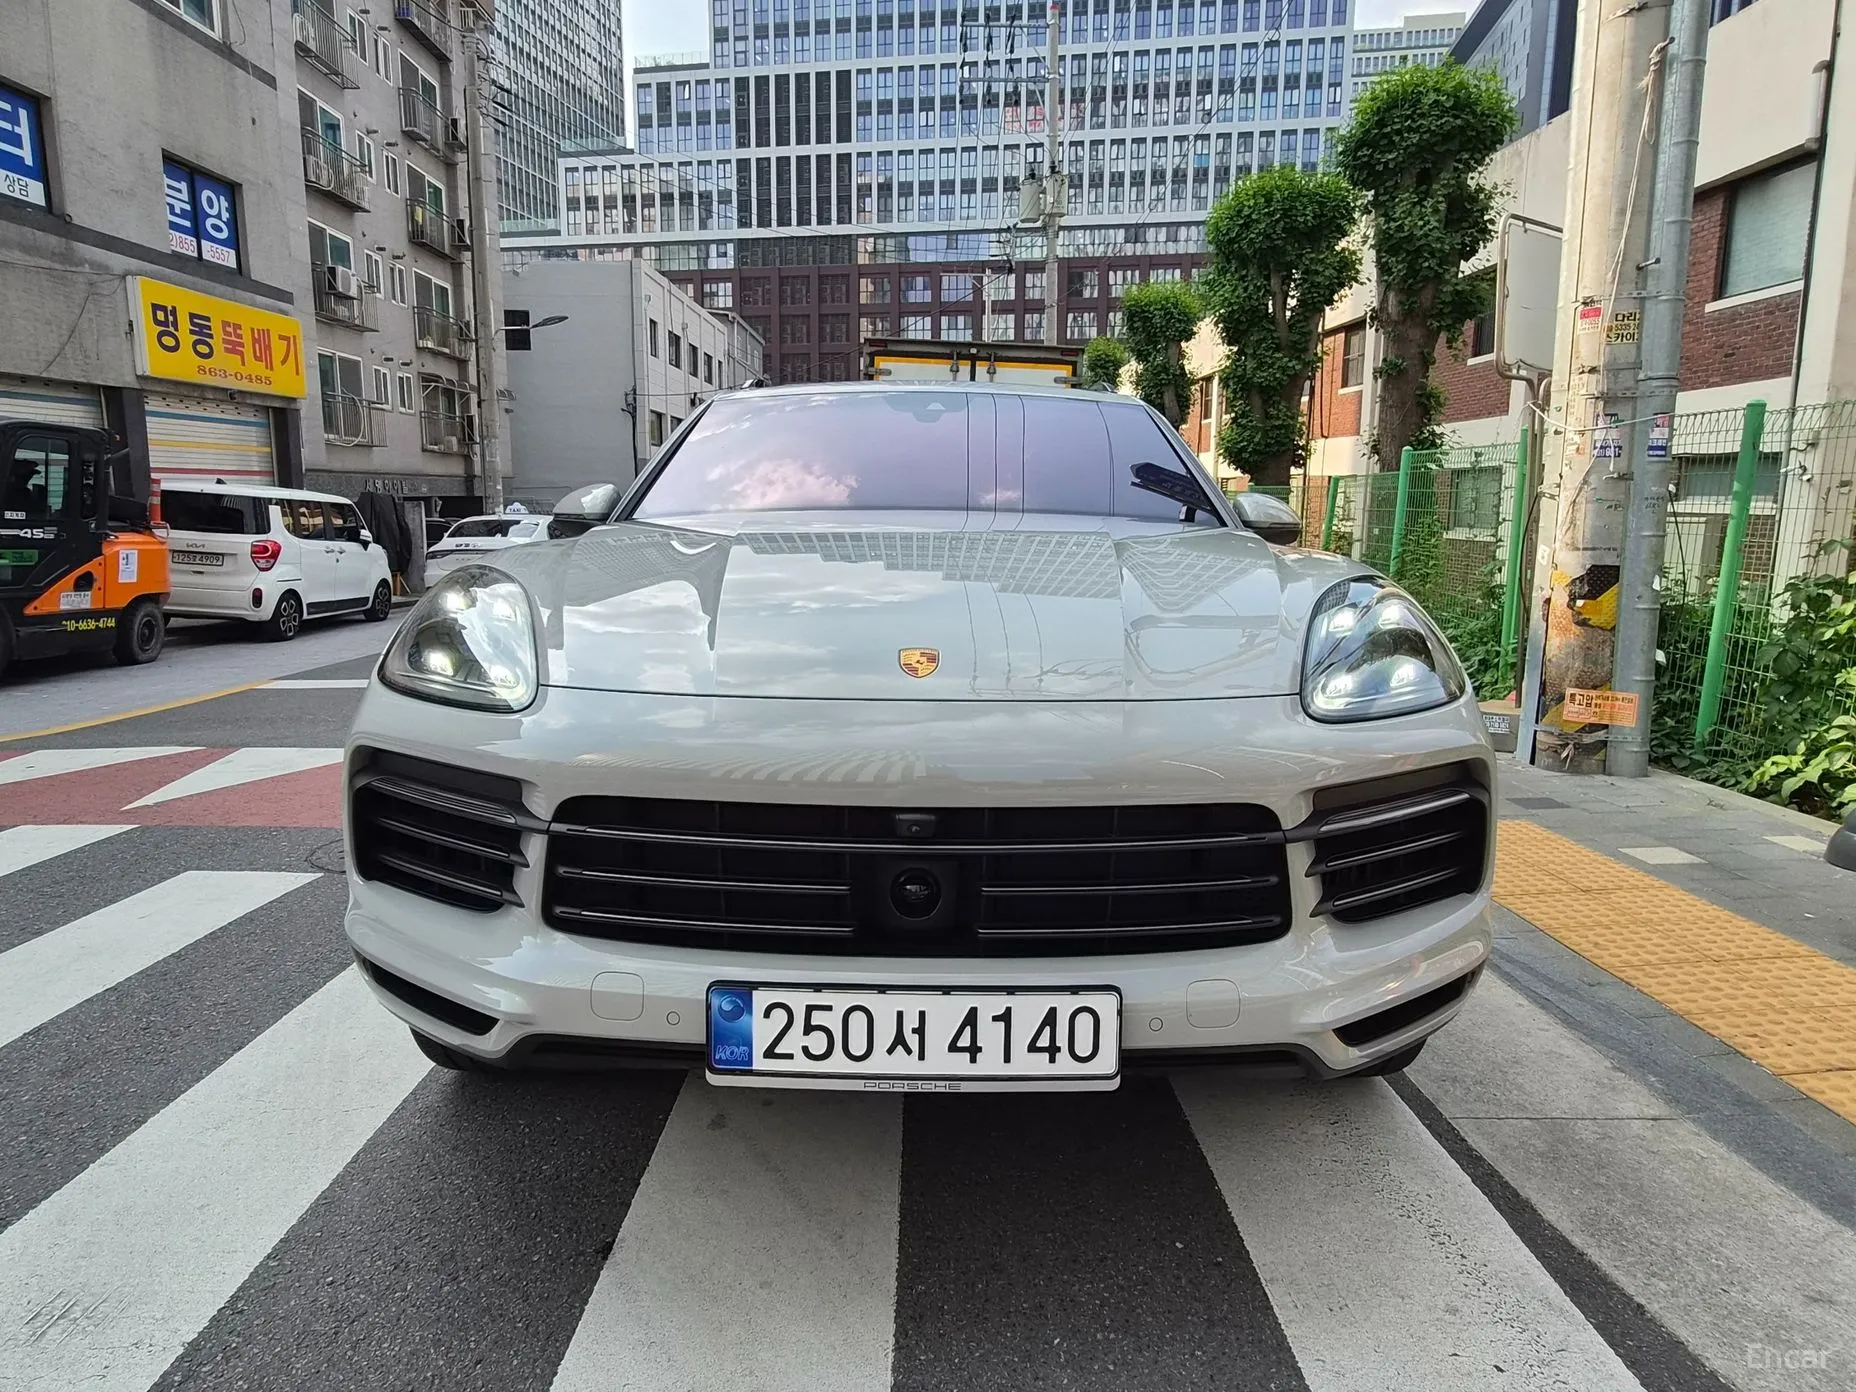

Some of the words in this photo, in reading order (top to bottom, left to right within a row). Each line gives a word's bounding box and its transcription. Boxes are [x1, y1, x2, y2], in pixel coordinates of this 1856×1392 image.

[4, 174, 29, 197] 상담
[197, 364, 273, 386] 863-0485
[763, 1001, 926, 1062] 250서
[947, 1005, 1101, 1064] 4140
[715, 1045, 750, 1061] KOR
[863, 1081, 962, 1091] PORSCHE
